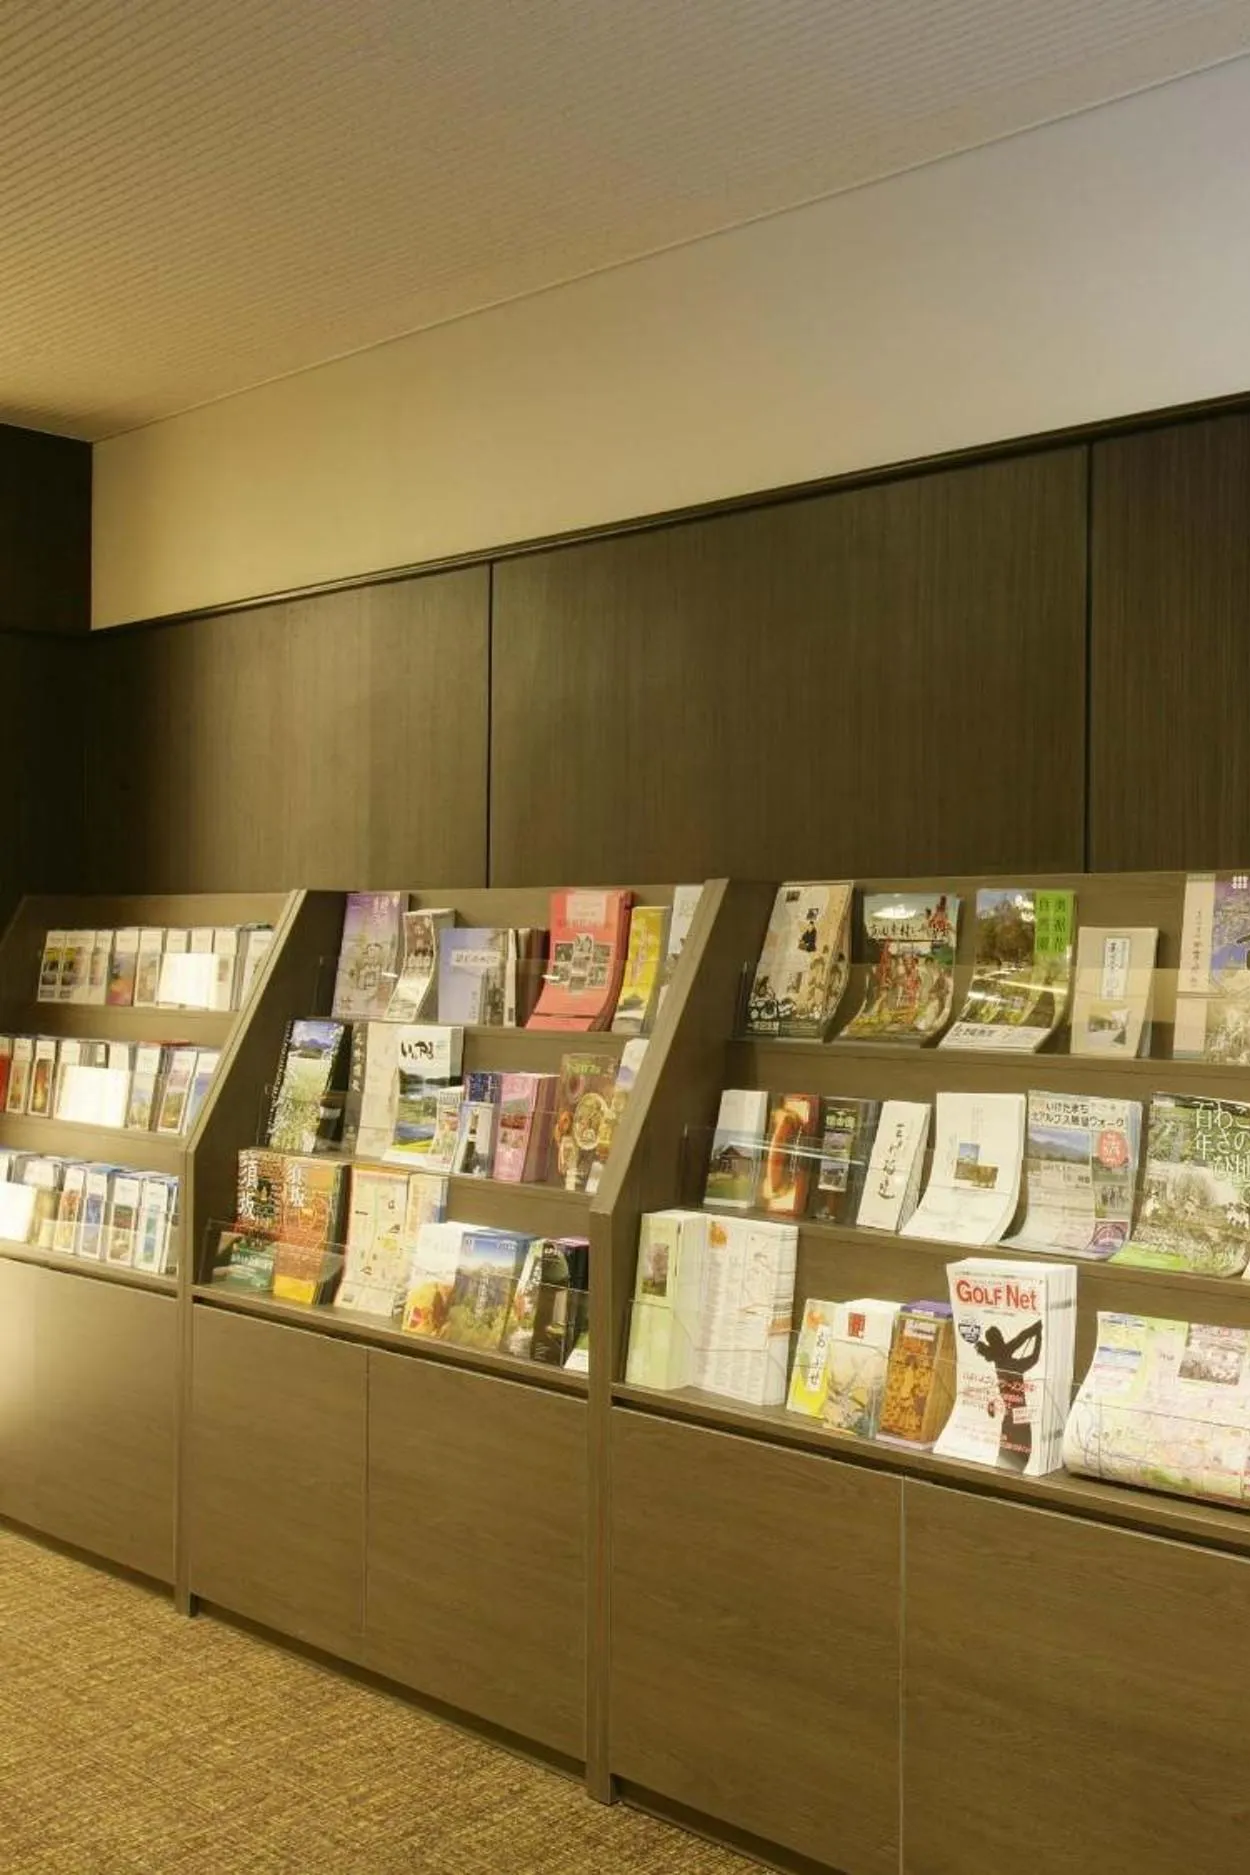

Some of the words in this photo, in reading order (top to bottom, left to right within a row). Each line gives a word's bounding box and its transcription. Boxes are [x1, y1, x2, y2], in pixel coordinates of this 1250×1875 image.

[1195, 1101, 1215, 1160] 百年
[956, 1279, 1003, 1307] GOLF
[1006, 1284, 1037, 1311] Net
